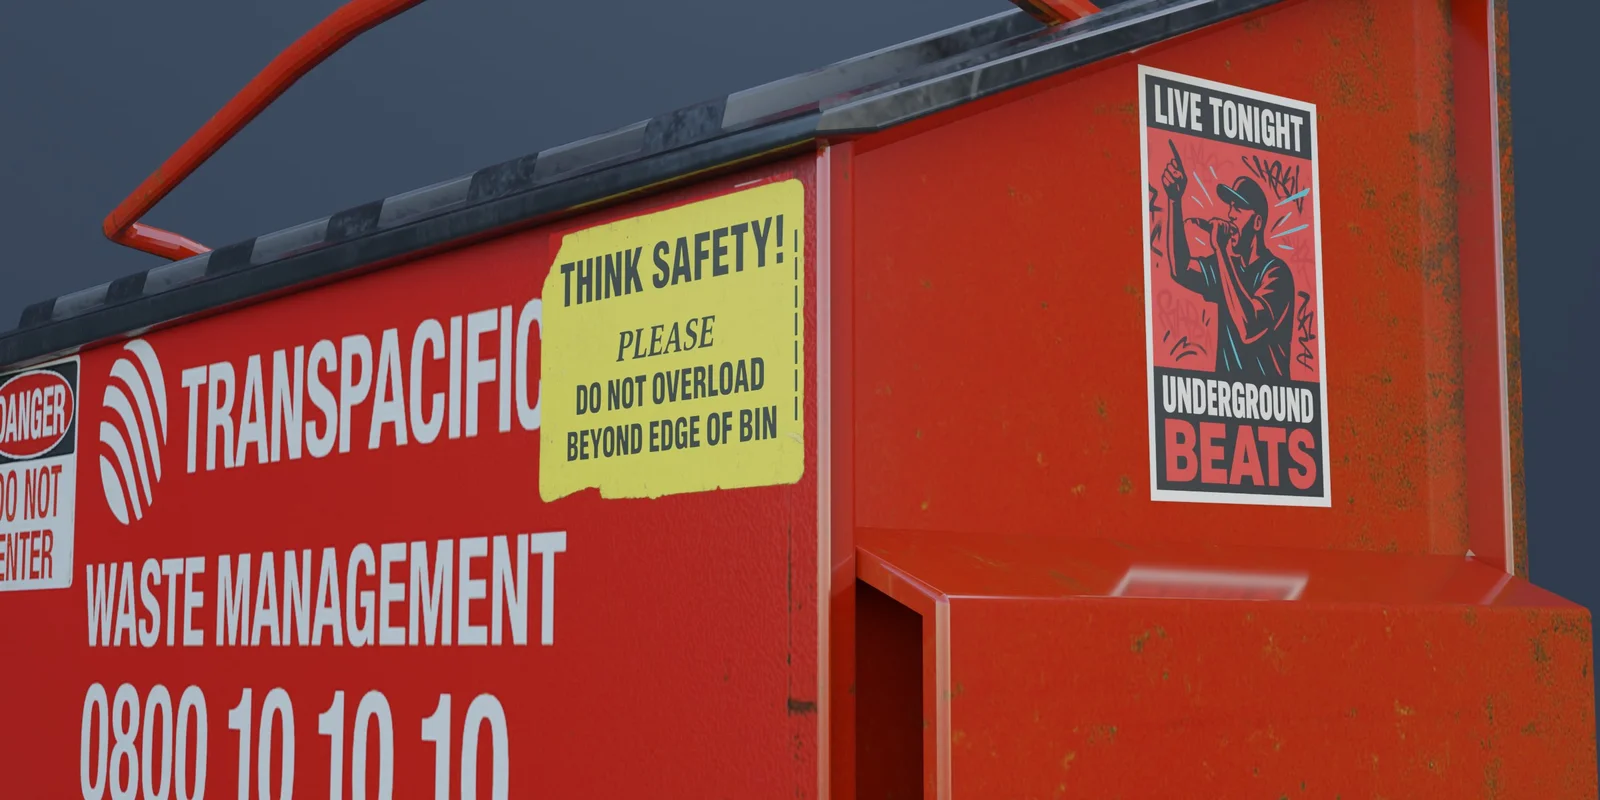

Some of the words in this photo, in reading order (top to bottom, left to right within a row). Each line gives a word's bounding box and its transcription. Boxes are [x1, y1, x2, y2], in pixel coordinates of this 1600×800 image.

[1154, 84, 1202, 132] LIVE
[1208, 96, 1303, 152] TONIGHT
[560, 247, 643, 307] THINK
[652, 214, 784, 289] SAFETY!
[616, 315, 715, 362] PLEASE
[181, 297, 543, 473] TRANSPACIFIC
[576, 382, 600, 415] DO
[607, 375, 647, 411] NOT
[652, 357, 765, 405] OVERLOAD
[1162, 374, 1314, 424] UNDERGROUND
[567, 423, 643, 462] BEYOND
[649, 415, 700, 453] EDGE
[706, 411, 732, 446] OF
[739, 405, 777, 443] BIN
[1164, 418, 1317, 490] BEATS
[24, 464, 62, 521] NOT
[86, 556, 205, 648] WASTE
[216, 531, 567, 648] MANAGEMENT
[80, 682, 208, 800] 0800
[228, 687, 295, 800] 10
[318, 690, 394, 800] 10
[421, 693, 509, 800] 10
